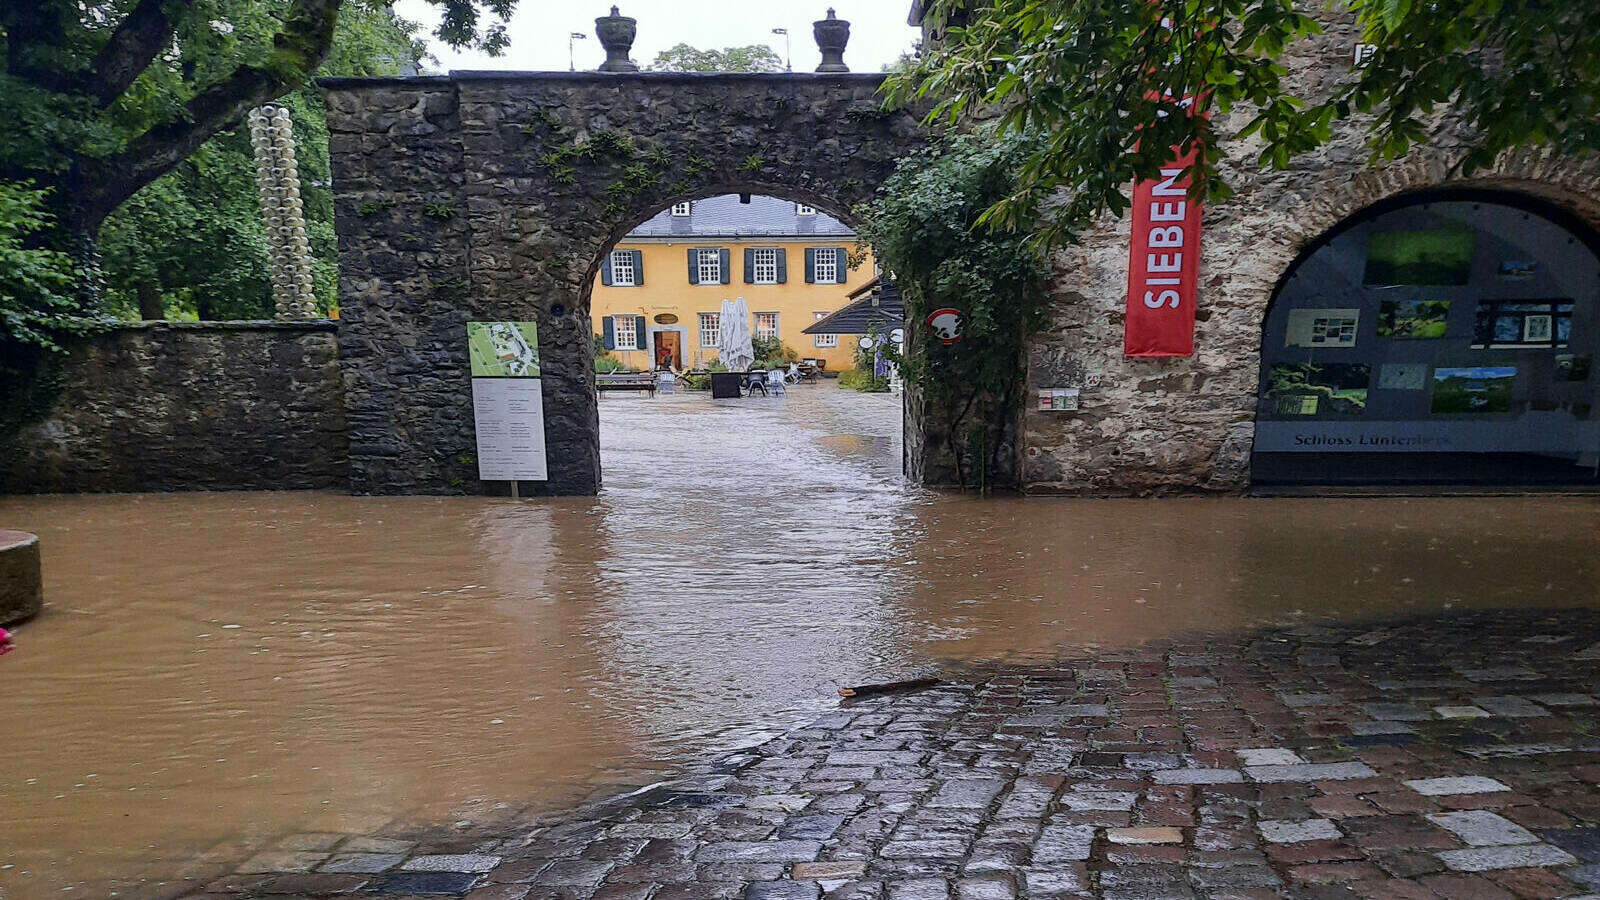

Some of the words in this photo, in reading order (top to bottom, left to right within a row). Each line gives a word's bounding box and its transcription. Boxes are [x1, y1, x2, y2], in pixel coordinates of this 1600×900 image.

[1144, 168, 1188, 309] SIEBEN
[1294, 434, 1352, 446] Schloss
[1359, 433, 1452, 446] Lünten
